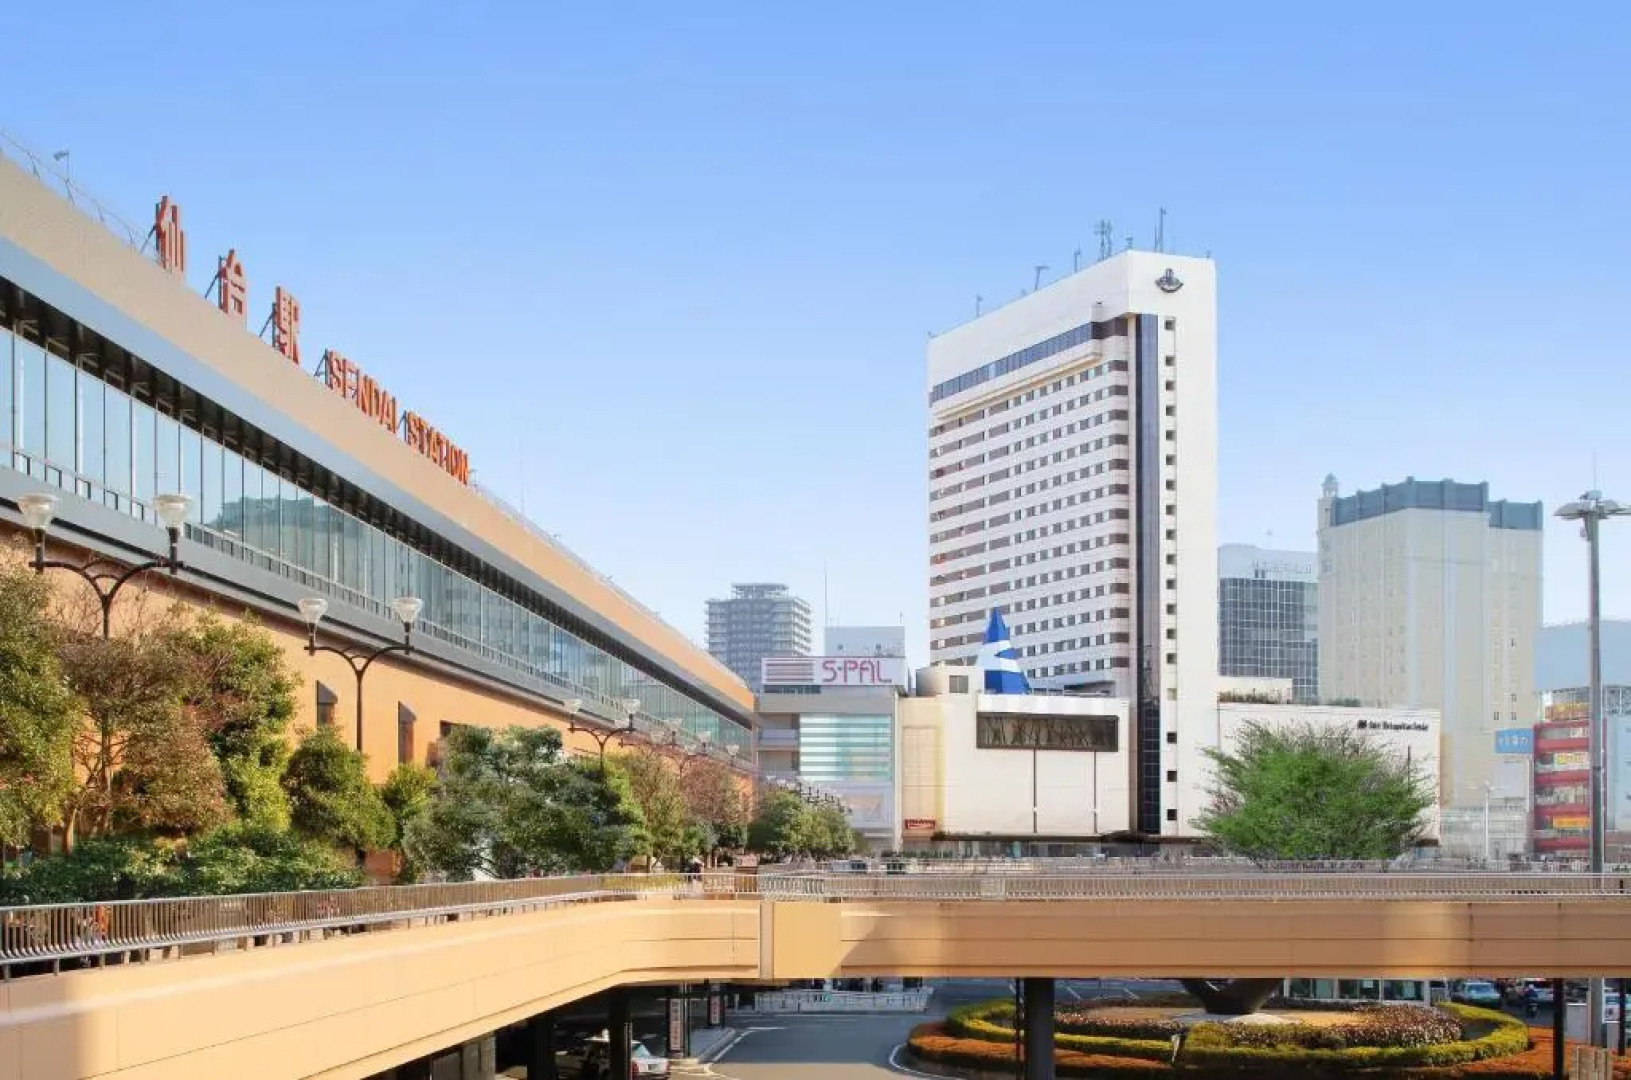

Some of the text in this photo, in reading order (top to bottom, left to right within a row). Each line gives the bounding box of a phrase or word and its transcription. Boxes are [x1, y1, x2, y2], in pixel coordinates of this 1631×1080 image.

[156, 195, 300, 366] 仙台駅
[328, 350, 469, 485] SENDAI STATION
